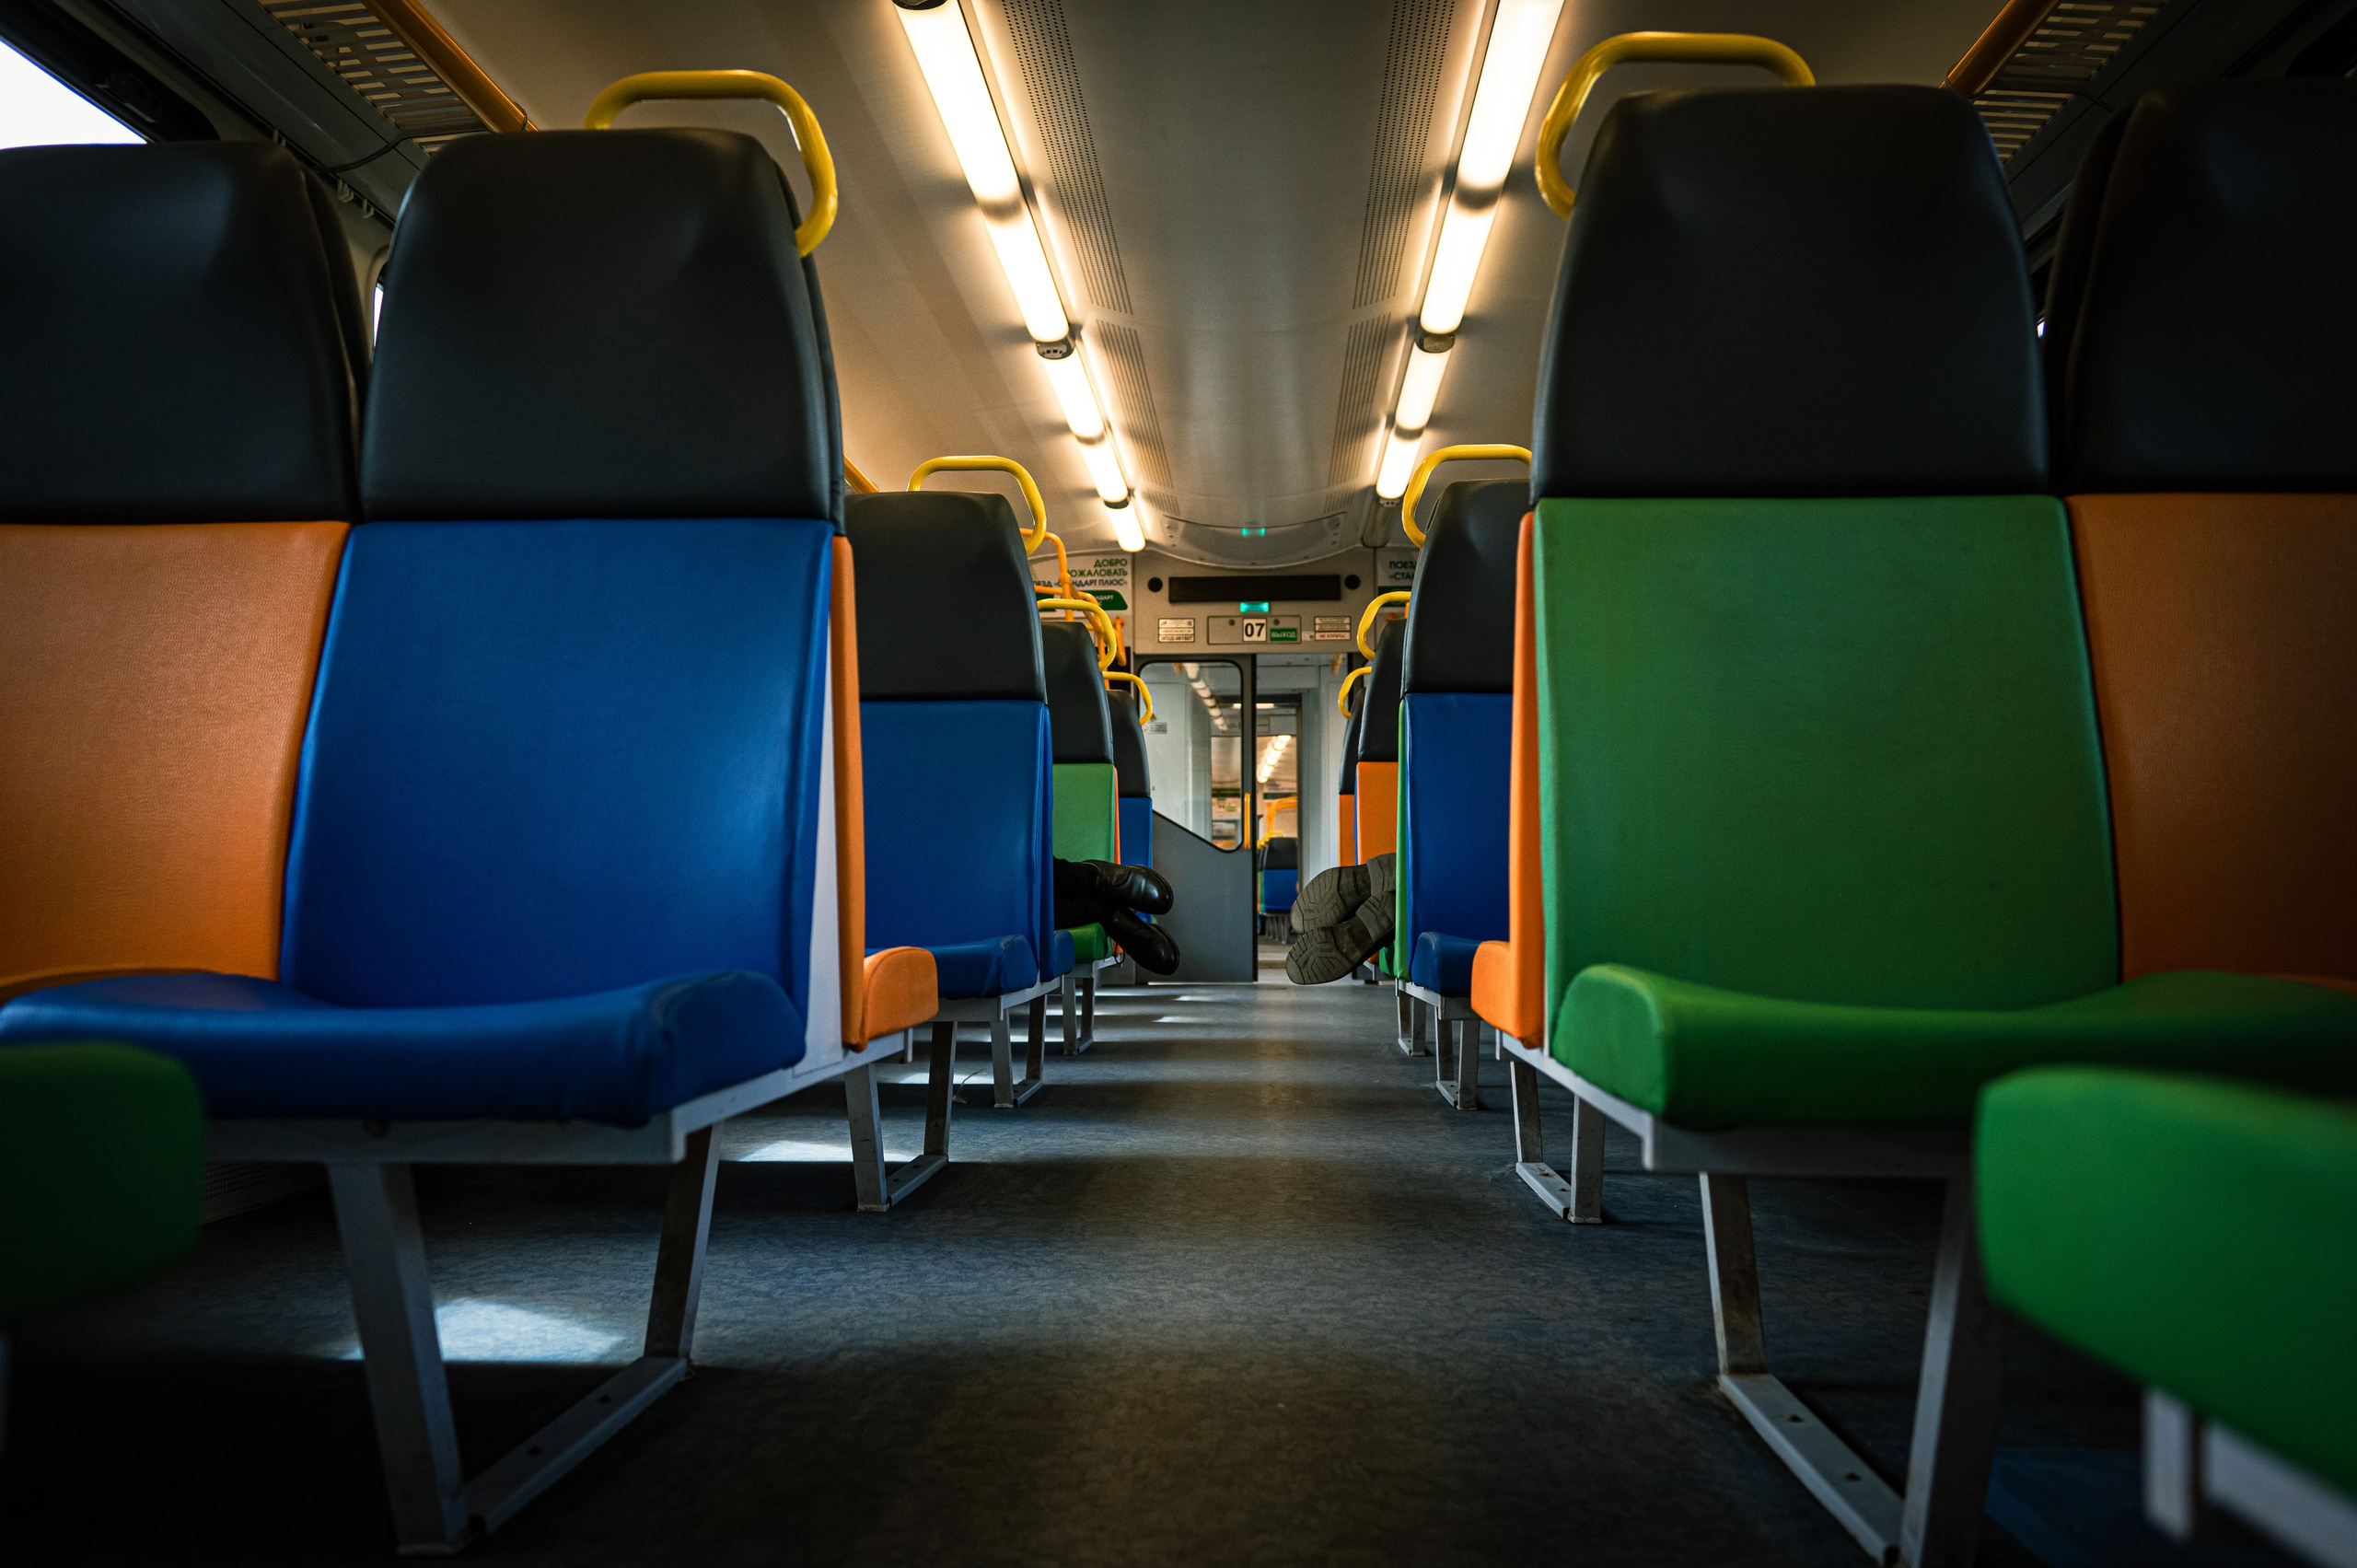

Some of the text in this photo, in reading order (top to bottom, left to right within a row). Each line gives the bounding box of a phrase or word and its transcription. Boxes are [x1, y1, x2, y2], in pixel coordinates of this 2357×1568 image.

[1094, 558, 1128, 568] ДОБРО
[1068, 568, 1128, 577] ОЖАЛОВАТЬ
[1245, 622, 1265, 637] 07
